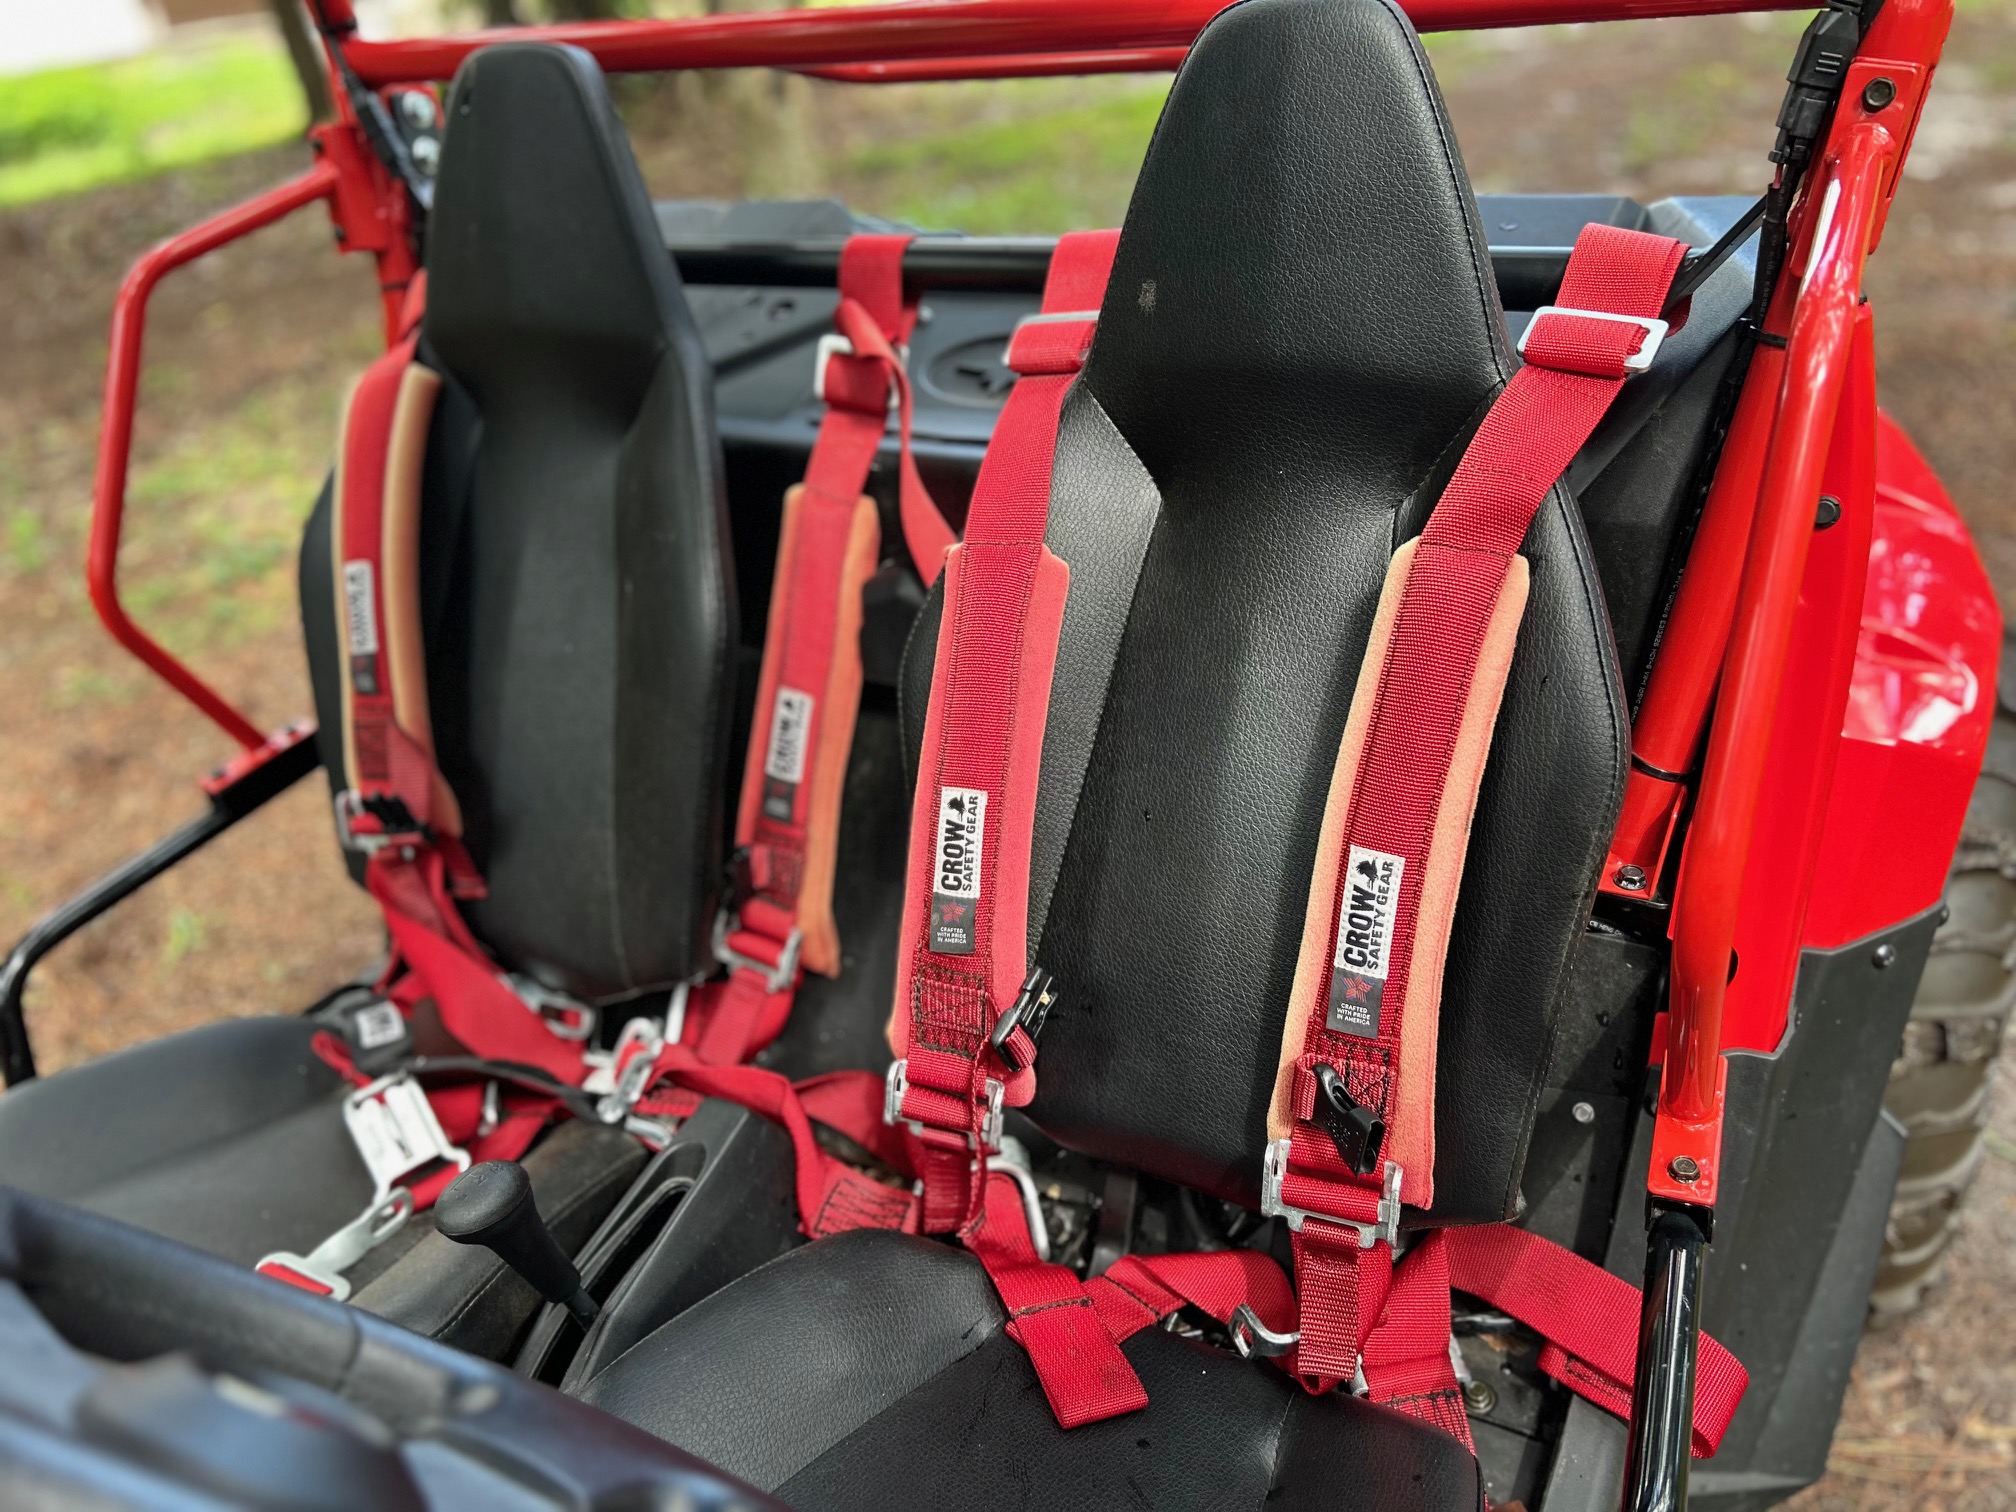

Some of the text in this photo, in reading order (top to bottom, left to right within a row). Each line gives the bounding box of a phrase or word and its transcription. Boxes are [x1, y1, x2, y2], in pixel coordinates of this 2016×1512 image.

[941, 819, 966, 891] CROW
[962, 796, 979, 891] SAFETY GEAR
[1343, 884, 1376, 968] CROW
[1367, 861, 1394, 970] SAFETY GEAR
[1336, 1007, 1371, 1020] WITH PRIDE
[1340, 1002, 1368, 1013] CRAFTED
[1344, 1015, 1371, 1026] AMERICA
